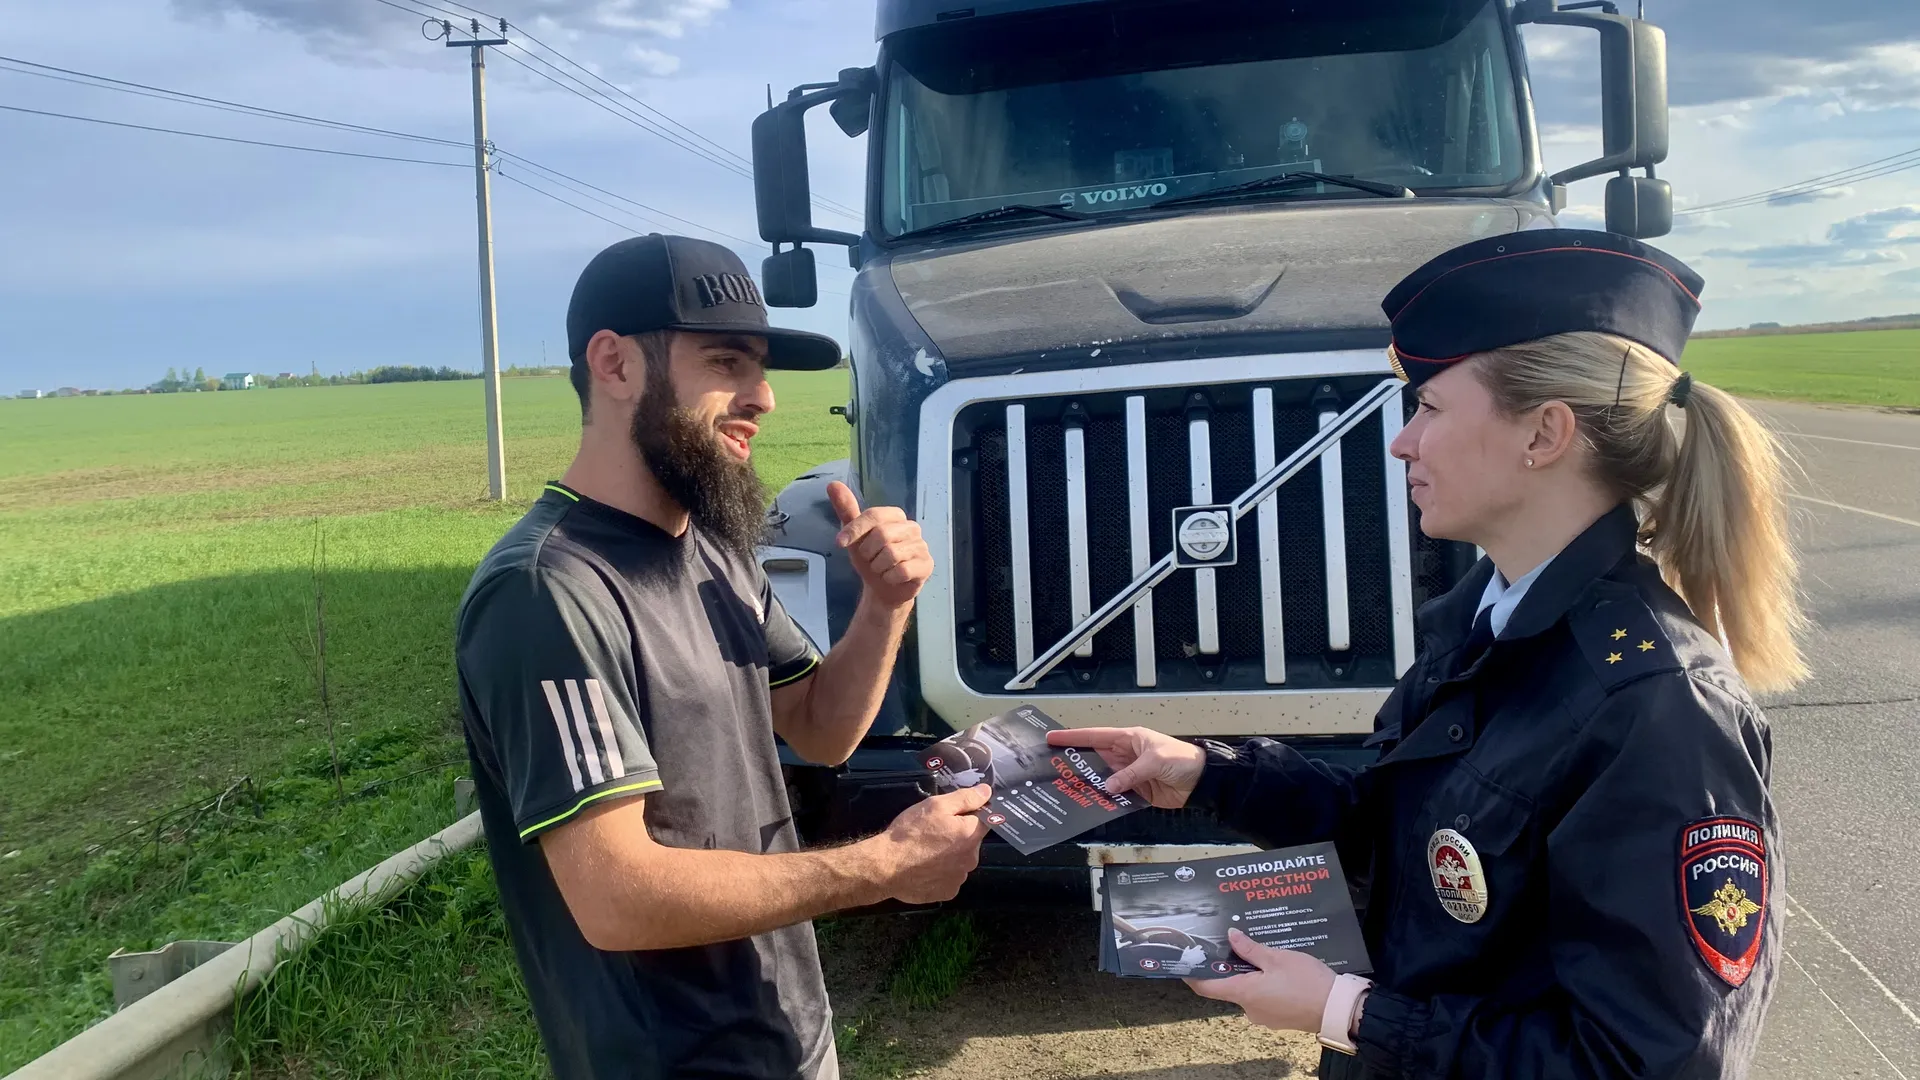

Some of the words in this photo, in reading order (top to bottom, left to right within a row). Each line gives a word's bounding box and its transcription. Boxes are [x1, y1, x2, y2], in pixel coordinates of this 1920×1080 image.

[1080, 183, 1167, 205] VOLVO
[692, 272, 763, 309] BOR
[1050, 756, 1118, 812] СКОРОСТНОЙ
[1064, 747, 1132, 807] СОБЛЮДТЕ
[1052, 778, 1094, 808] РЕЖИМ!
[1440, 834, 1470, 857] РОССИИ
[1688, 824, 1759, 847] ПОЛИЦИЯ
[1215, 855, 1326, 878] СОБЛЮДАЙТЕ
[1692, 855, 1759, 880] РОССИЯ
[1219, 867, 1330, 893] СКОРОСТНОЙ
[1245, 883, 1312, 902] РЕЖИМ!
[1440, 889, 1479, 902] ПОЛИЦИЯ
